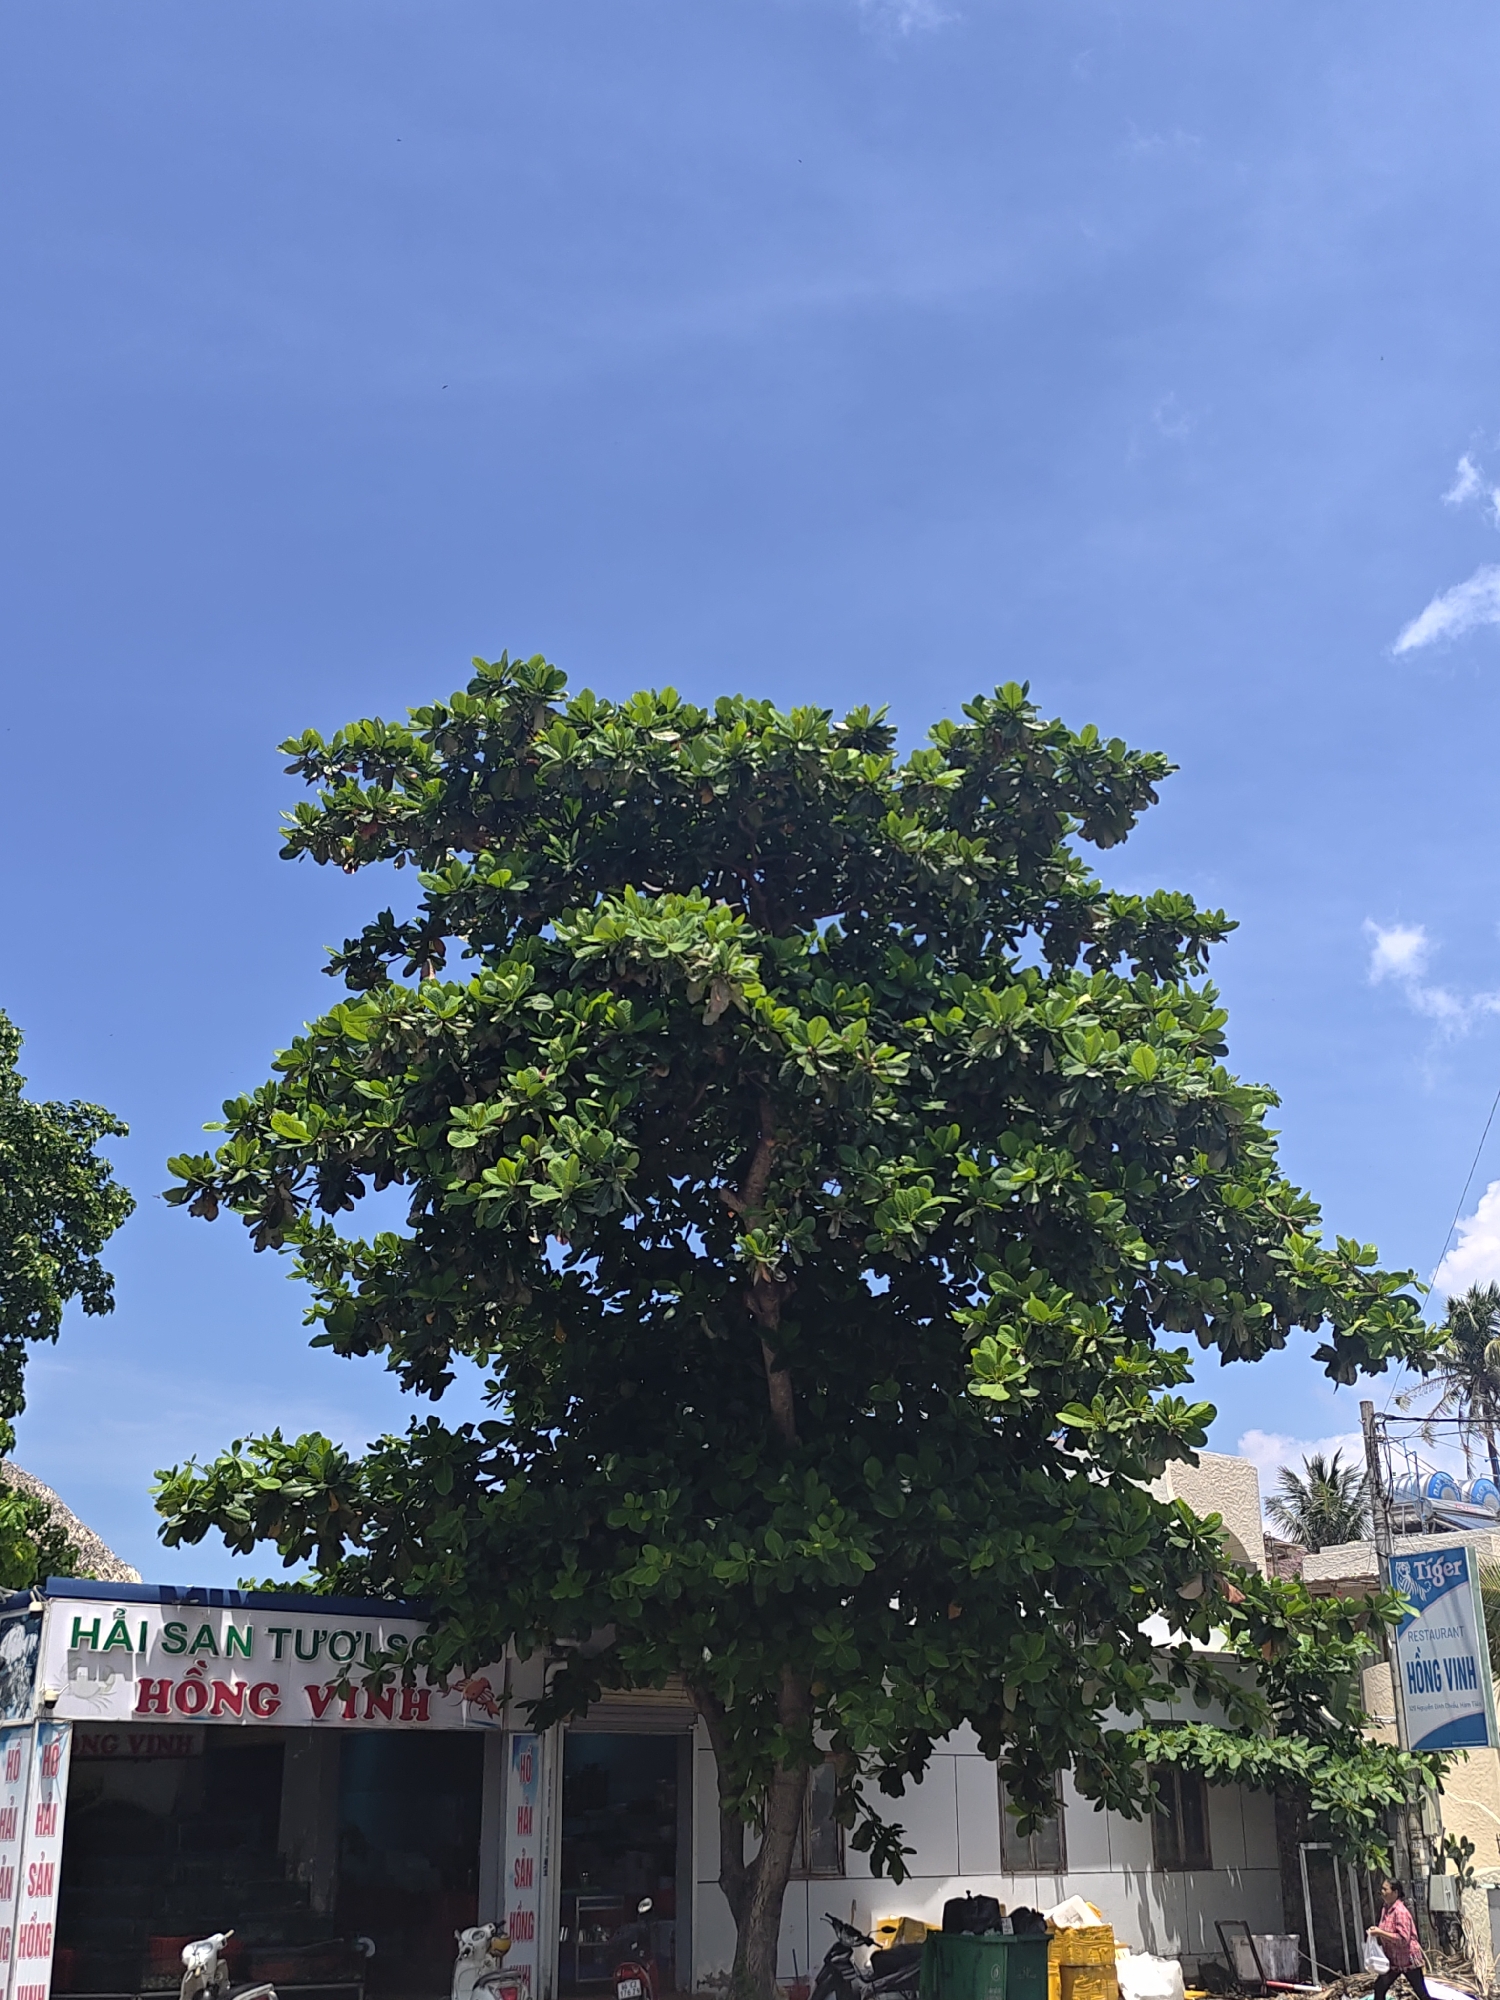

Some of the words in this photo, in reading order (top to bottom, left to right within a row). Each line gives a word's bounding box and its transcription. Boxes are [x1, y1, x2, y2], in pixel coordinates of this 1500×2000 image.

[1413, 1555, 1463, 1587] Tiger
[70, 1607, 148, 1652] HẢI
[1408, 1625, 1464, 1642] RESTAURANT
[134, 1659, 282, 1718] HỒNG
[304, 1684, 432, 1721] VINH
[1406, 1646, 1442, 1695] HỒNG
[1443, 1655, 1478, 1692] VINH
[73, 1733, 119, 1756] NG
[0, 1795, 18, 1841] HẢI
[35, 1791, 58, 1837] HẢI
[517, 1796, 533, 1836] HẢI
[0, 1854, 15, 1901] ẢN
[28, 1851, 55, 1898] SẢN
[515, 1847, 533, 1888] SẢN
[17, 1911, 53, 1959] HỒNG
